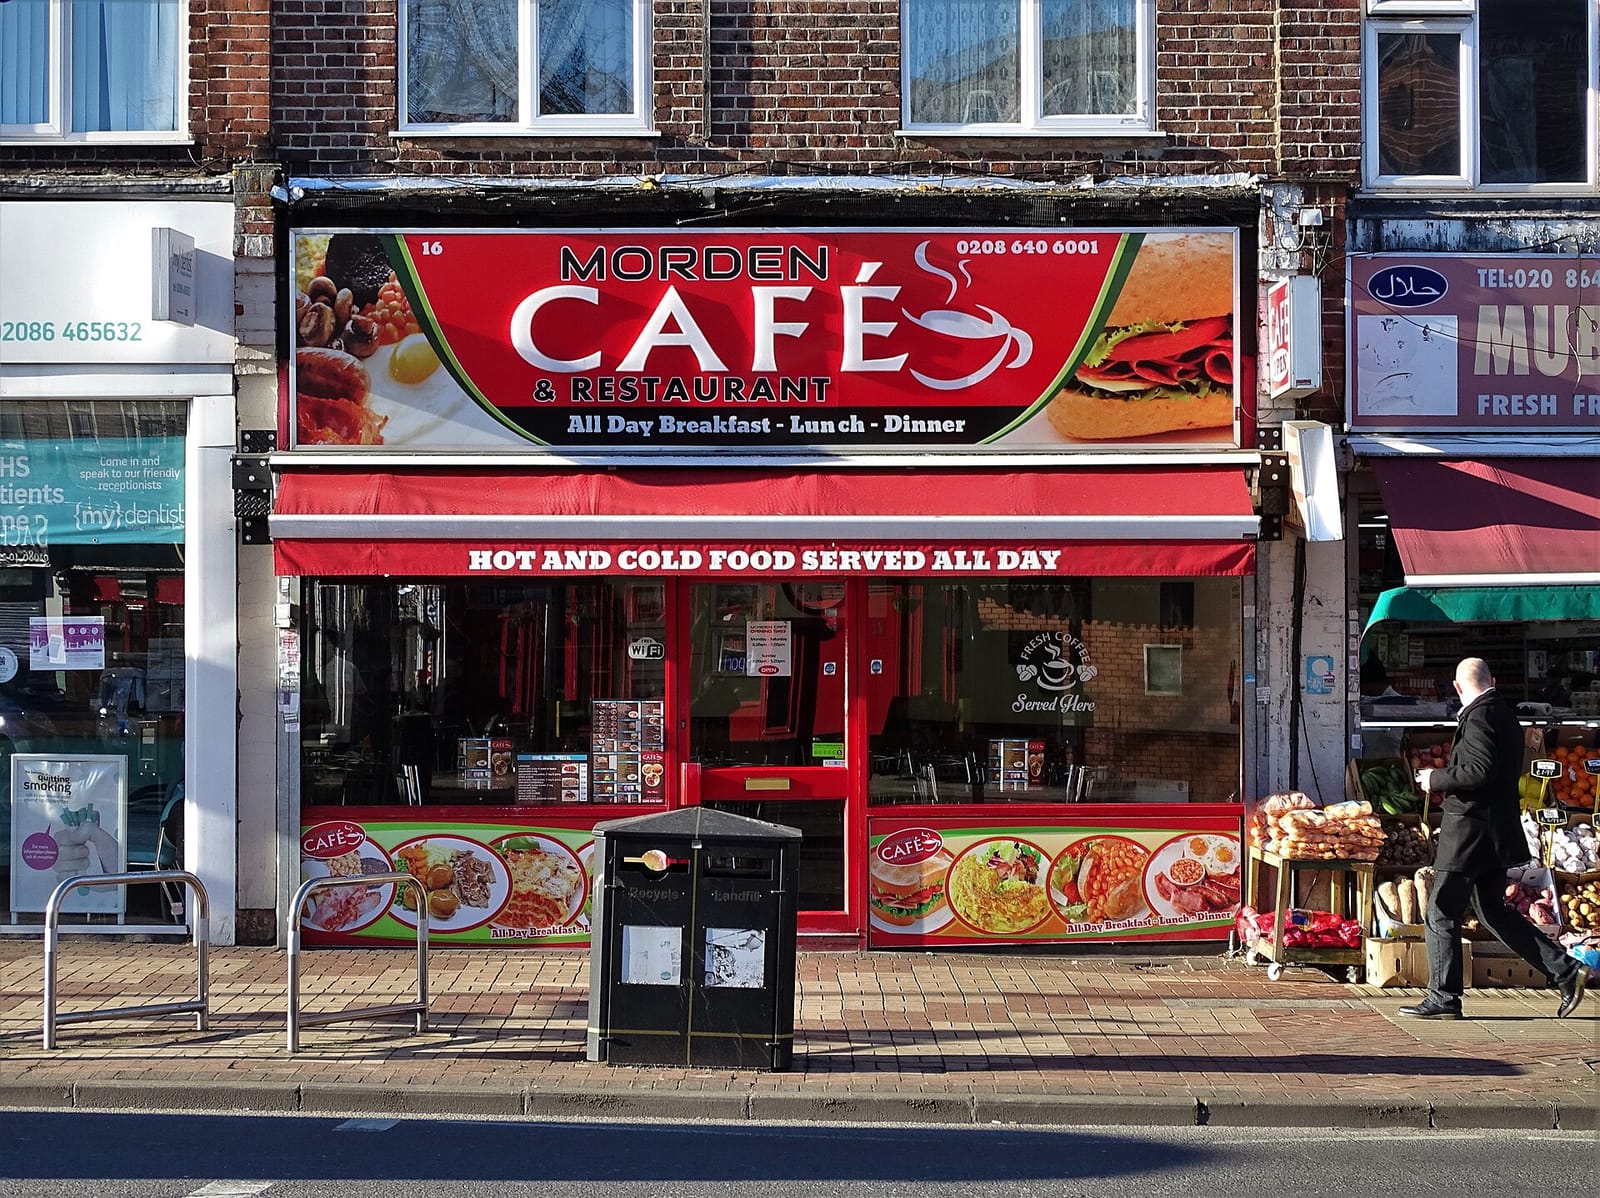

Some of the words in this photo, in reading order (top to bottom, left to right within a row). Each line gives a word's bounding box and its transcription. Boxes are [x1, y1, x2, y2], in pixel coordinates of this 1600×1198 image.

[421, 241, 443, 256] 16
[956, 240, 1007, 255] 0208
[1010, 240, 1049, 255] 640
[1052, 240, 1099, 255] 6001
[560, 245, 829, 281] MORDEN
[1477, 268, 1553, 288] TEL:020
[509, 261, 909, 373] CAFÉ
[0, 322, 55, 341] 2086
[62, 322, 142, 341] 465632
[533, 379, 557, 402] &
[570, 376, 831, 402] RESTAURANT
[1477, 394, 1558, 416] FRESH
[567, 415, 601, 433] All
[607, 415, 654, 437] Day
[659, 415, 771, 433] Breakfast
[790, 415, 865, 433] Lunch
[884, 415, 966, 433] Dinner
[100, 456, 127, 466] Come
[130, 456, 139, 466] in
[141, 456, 160, 466] and
[80, 468, 109, 480] speak
[112, 469, 122, 478] to
[143, 468, 181, 480] friendly
[99, 480, 162, 492] receptionists
[468, 550, 536, 570] HOT
[541, 550, 611, 570] AND
[617, 550, 702, 570] COLD
[708, 550, 795, 570] FOOD
[801, 550, 925, 570] SERVED
[931, 550, 990, 570] ALL
[996, 550, 1061, 570] DAY
[1020, 632, 1051, 660] FRESH
[1055, 631, 1091, 664] COFFEE
[1011, 693, 1059, 713] Served
[1059, 694, 1096, 714] Here
[23, 781, 72, 795] smoking
[38, 774, 71, 784] quitting
[303, 829, 347, 852] CAFÉ
[881, 836, 924, 860] CAFÉ
[629, 887, 680, 902] Recycle
[714, 889, 761, 902] Landfill
[1066, 924, 1081, 933] All
[1084, 922, 1103, 933] Day
[1105, 917, 1152, 930] Breakfast
[1159, 913, 1190, 925] Lunch
[1197, 911, 1231, 921] Dinner
[491, 928, 506, 938] All
[508, 928, 528, 939] Day
[529, 926, 577, 936] Breakfast
